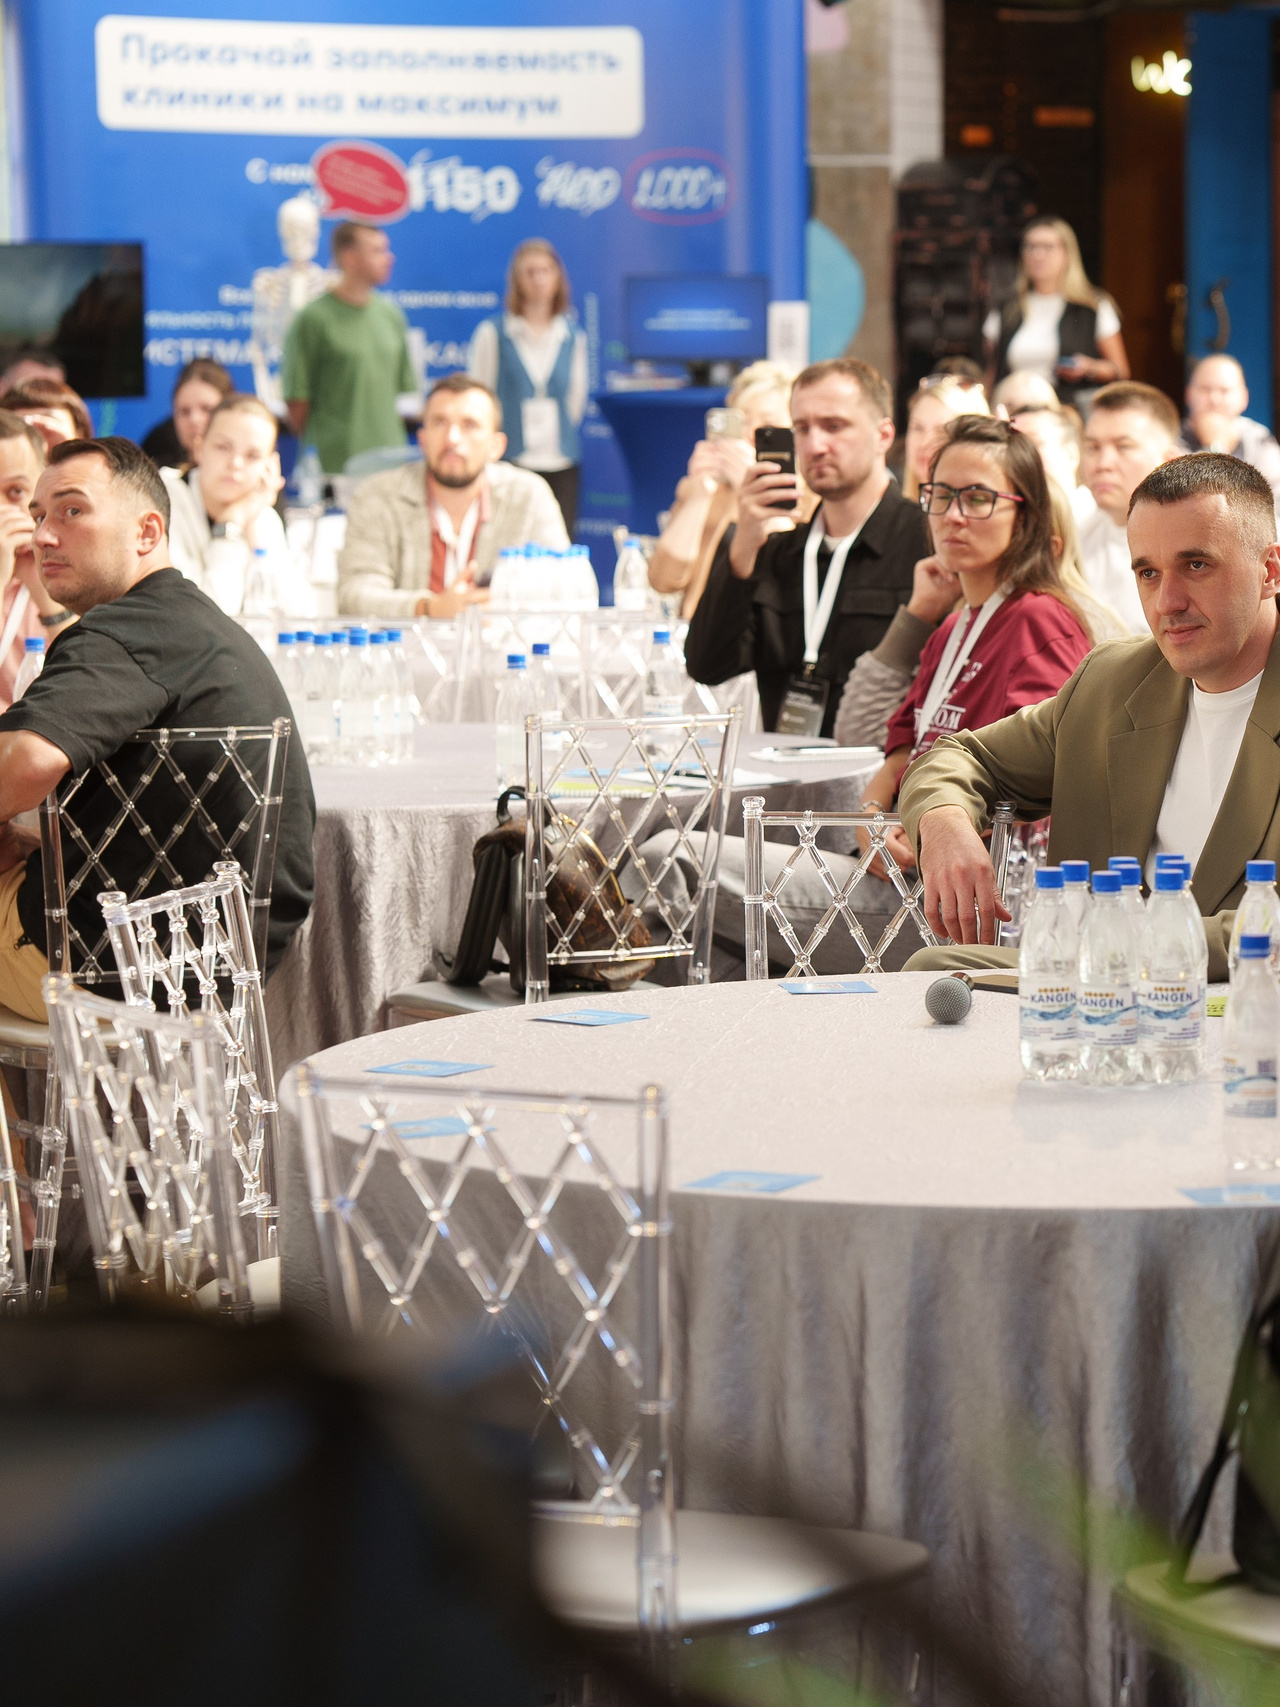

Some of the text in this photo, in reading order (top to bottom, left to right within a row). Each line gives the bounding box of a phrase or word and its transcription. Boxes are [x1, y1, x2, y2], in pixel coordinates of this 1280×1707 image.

[121, 33, 621, 73] Прокачай заполняемость
[121, 87, 562, 125] клиники на максимум
[1148, 992, 1193, 1003] KANGEN
